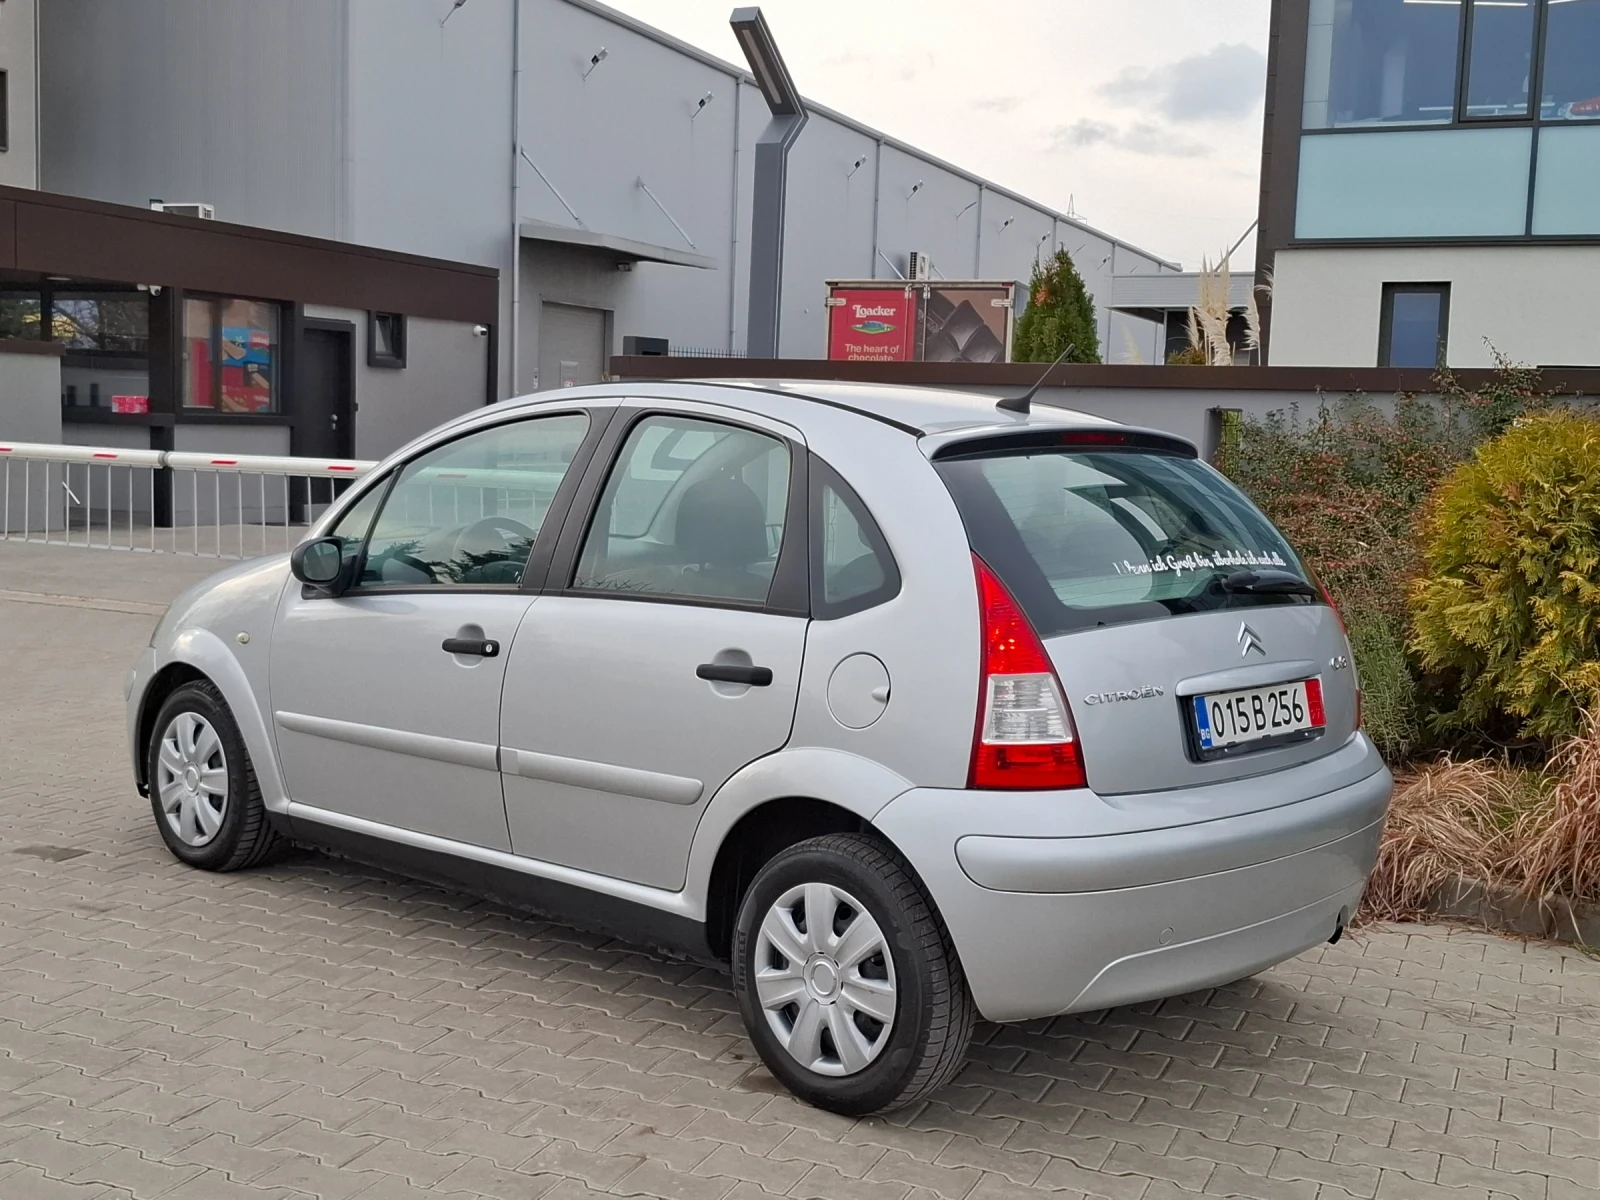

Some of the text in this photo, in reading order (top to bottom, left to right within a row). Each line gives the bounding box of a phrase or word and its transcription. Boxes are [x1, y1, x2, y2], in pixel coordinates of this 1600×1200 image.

[852, 304, 896, 318] Loacker
[845, 343, 900, 354] The heart of
[1083, 684, 1164, 706] CITROËN
[1200, 728, 1211, 740] BG
